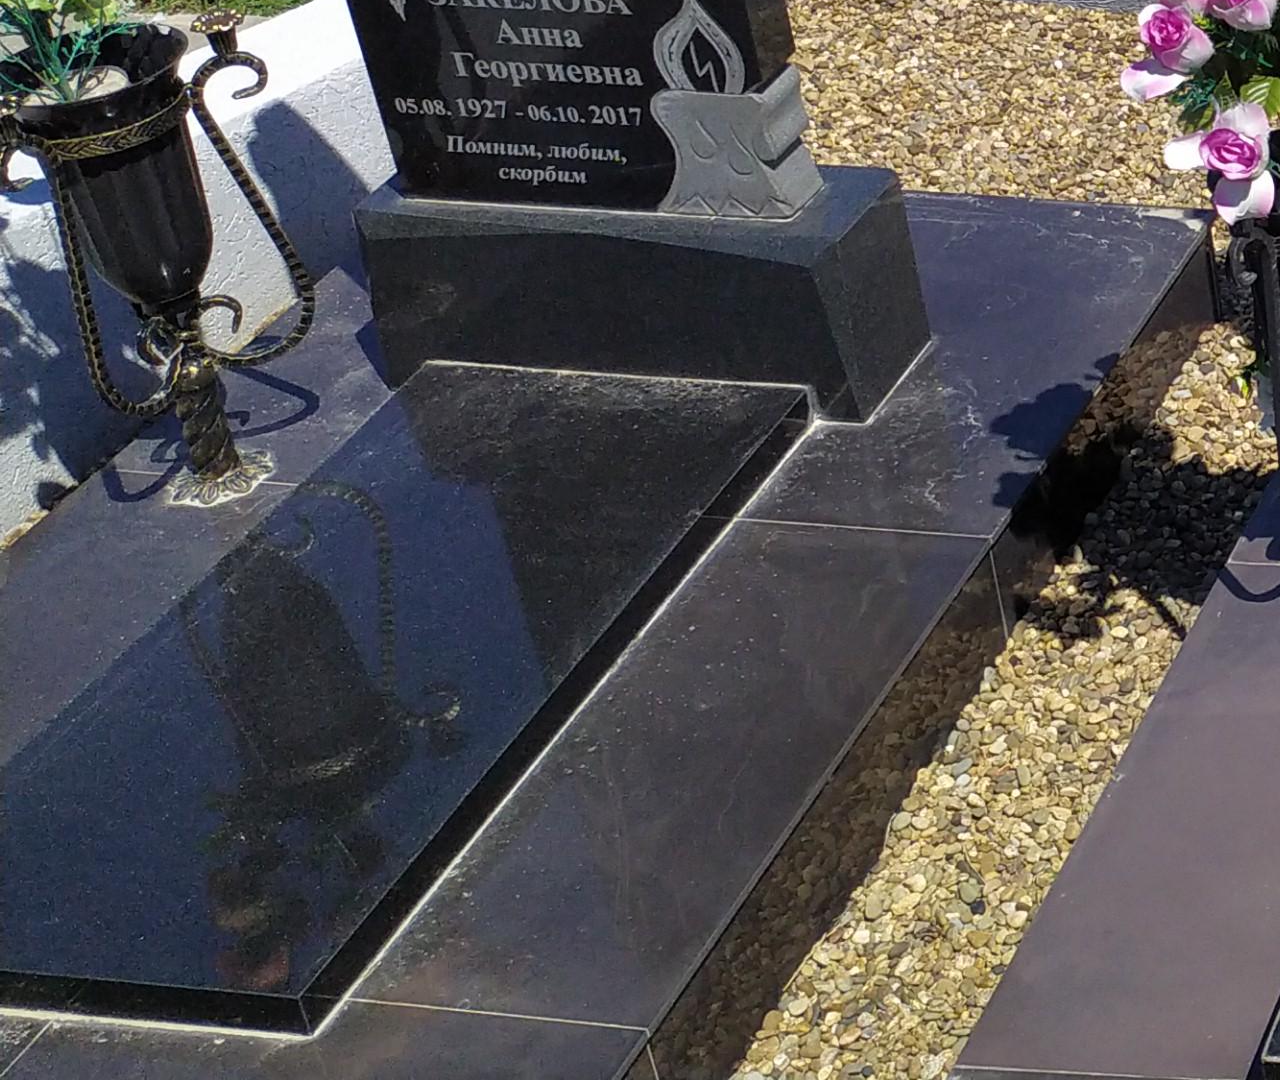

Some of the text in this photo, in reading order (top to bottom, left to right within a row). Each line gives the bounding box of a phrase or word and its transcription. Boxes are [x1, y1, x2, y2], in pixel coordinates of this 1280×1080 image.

[495, 20, 584, 50] Анна
[449, 51, 644, 88] Георгиевна
[394, 96, 452, 117] 05.08.
[455, 97, 507, 119] 1927
[527, 104, 586, 125] 06.10.
[588, 105, 642, 127] 2017
[446, 135, 628, 165] Помним, любим,
[498, 165, 588, 187] скорбим
